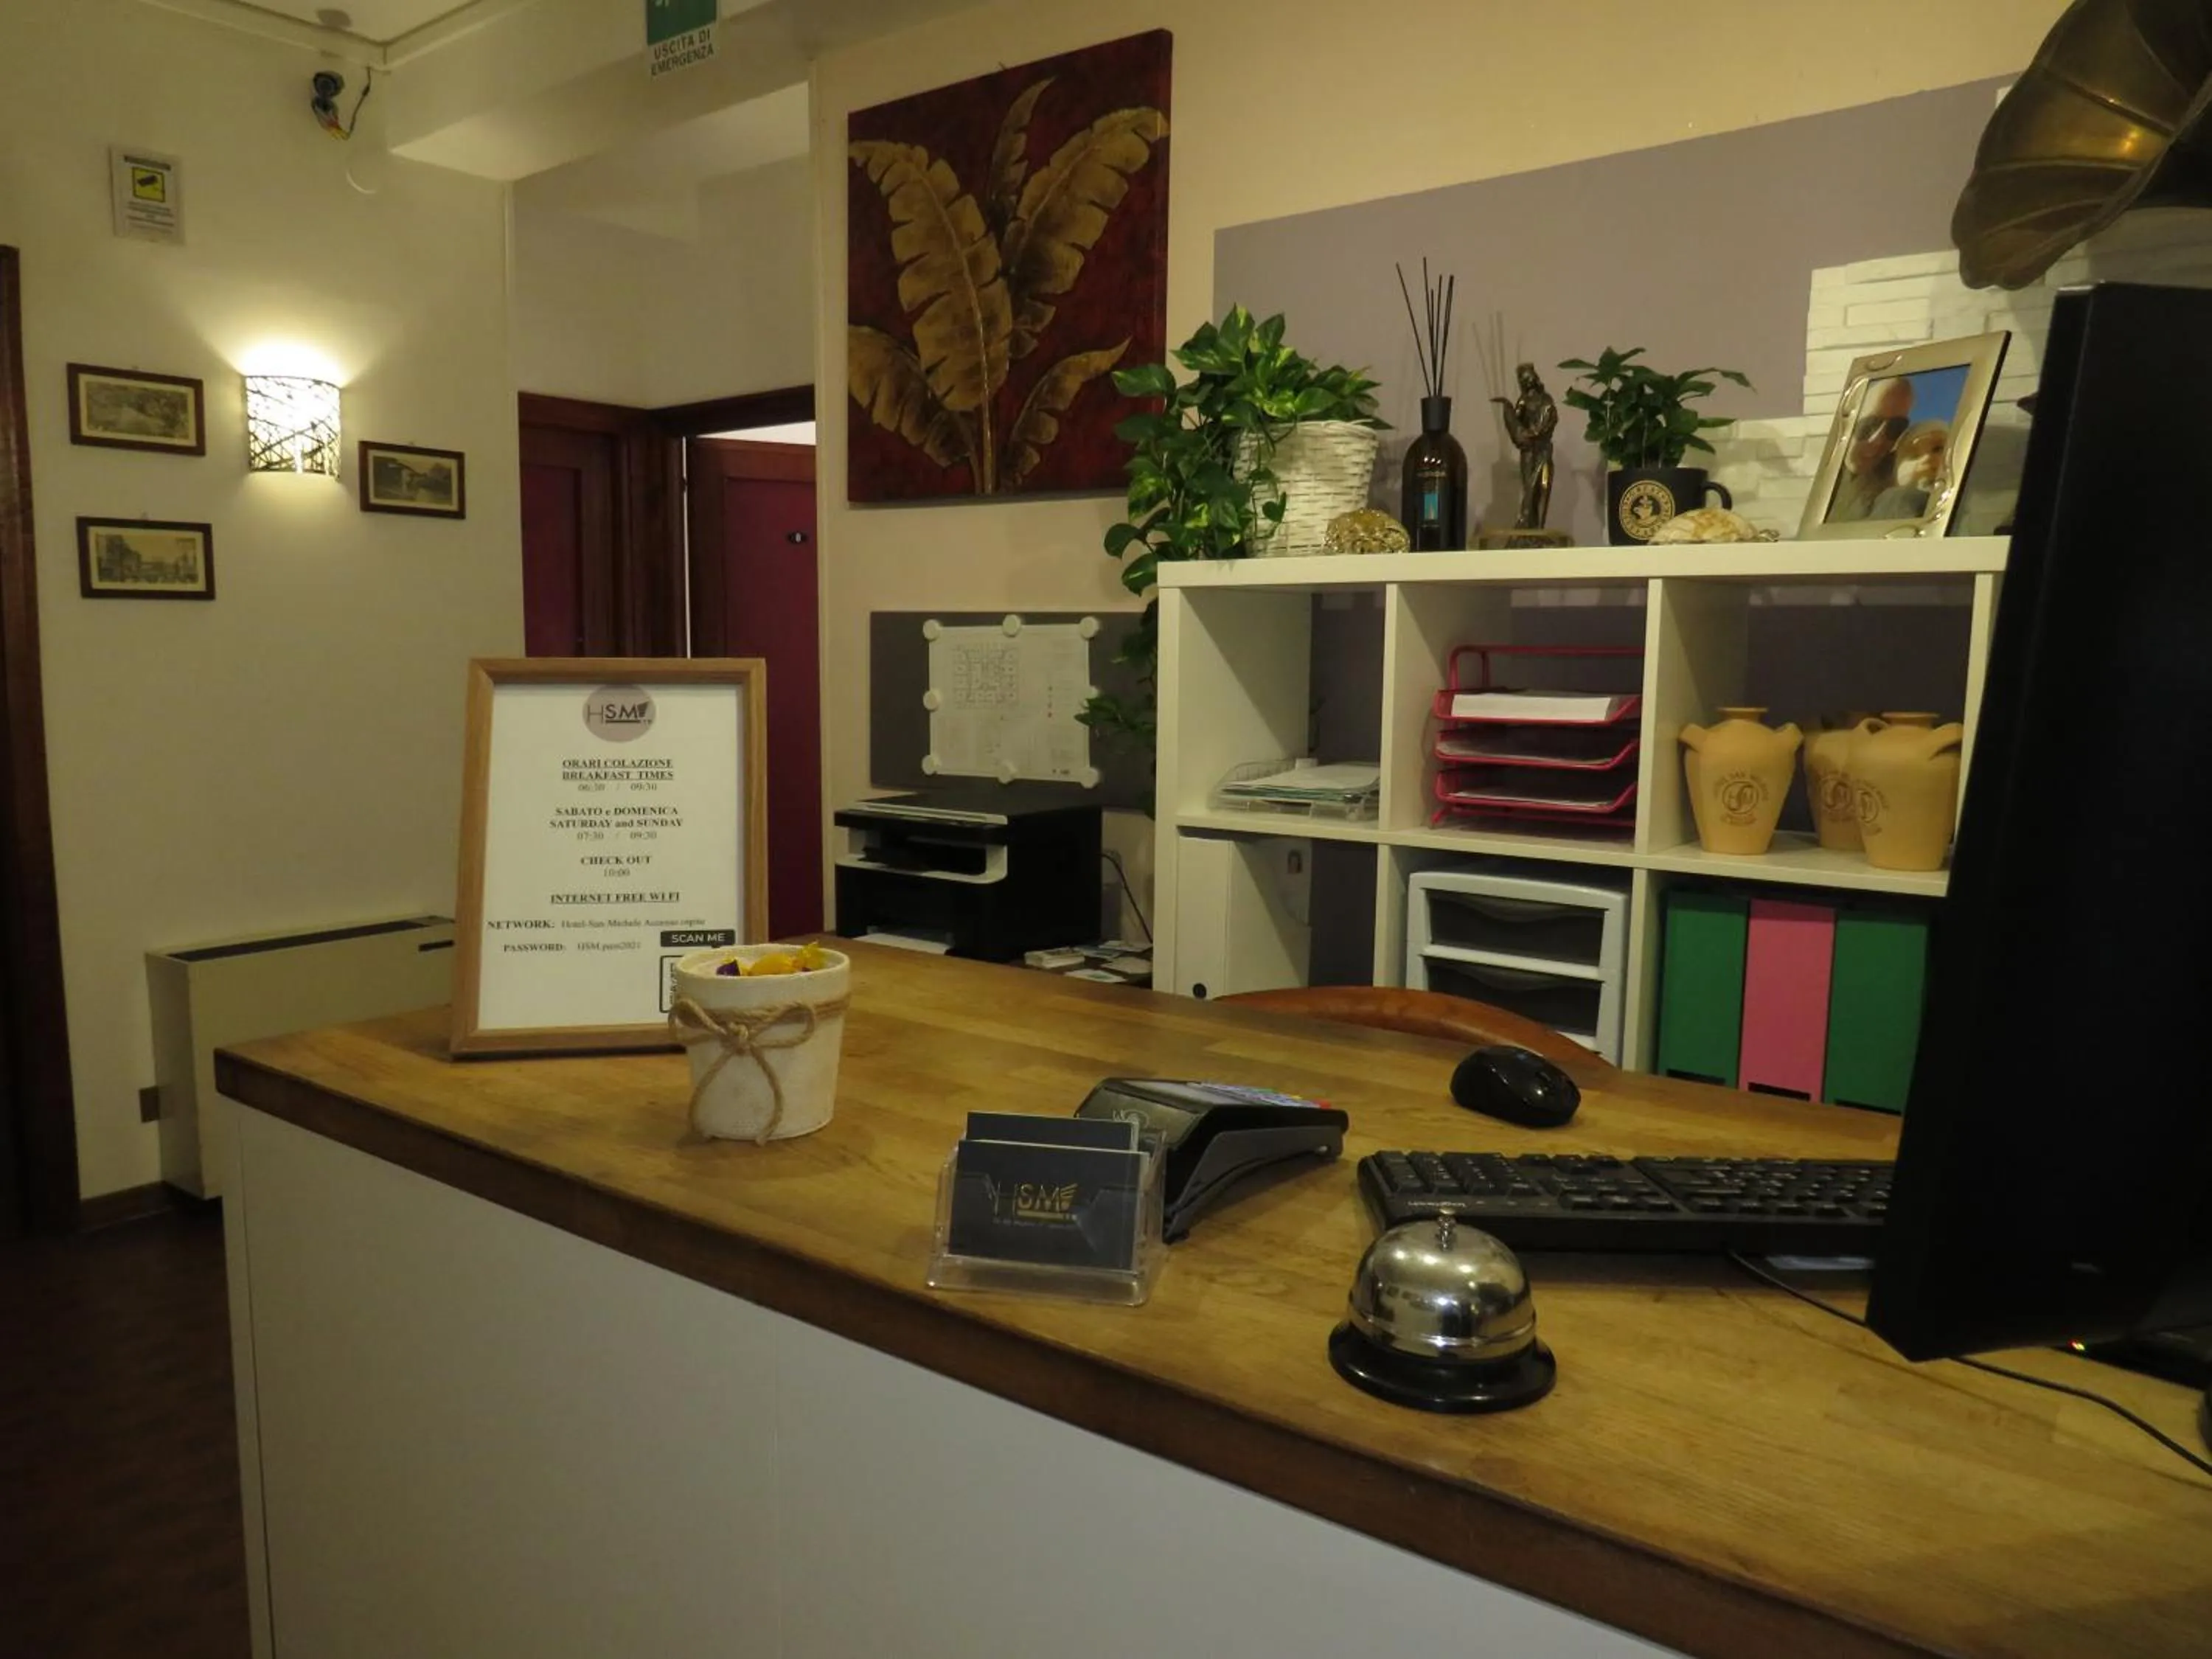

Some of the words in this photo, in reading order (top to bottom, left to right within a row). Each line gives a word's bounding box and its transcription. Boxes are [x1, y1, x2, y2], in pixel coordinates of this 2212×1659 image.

[653, 34, 695, 60] USCITA
[698, 28, 710, 44] DI
[650, 43, 714, 76] EMERGENZA
[562, 759, 601, 769] ORARI
[603, 759, 673, 768] COLAZIONE
[562, 771, 630, 781] BREAKFAST
[638, 771, 674, 780] TIMES
[555, 807, 602, 816] SABATO
[613, 807, 678, 815] DOMENICA
[549, 819, 612, 829] SATURDAY
[615, 819, 634, 827] and
[636, 818, 683, 827] SUNDAY
[580, 855, 624, 865] CHECK
[626, 855, 652, 864] OUT
[550, 893, 611, 904] INTERNET
[614, 892, 645, 903] FREE
[487, 919, 555, 929] NETWORK:
[672, 933, 705, 943] SCAN
[707, 933, 726, 942] ME
